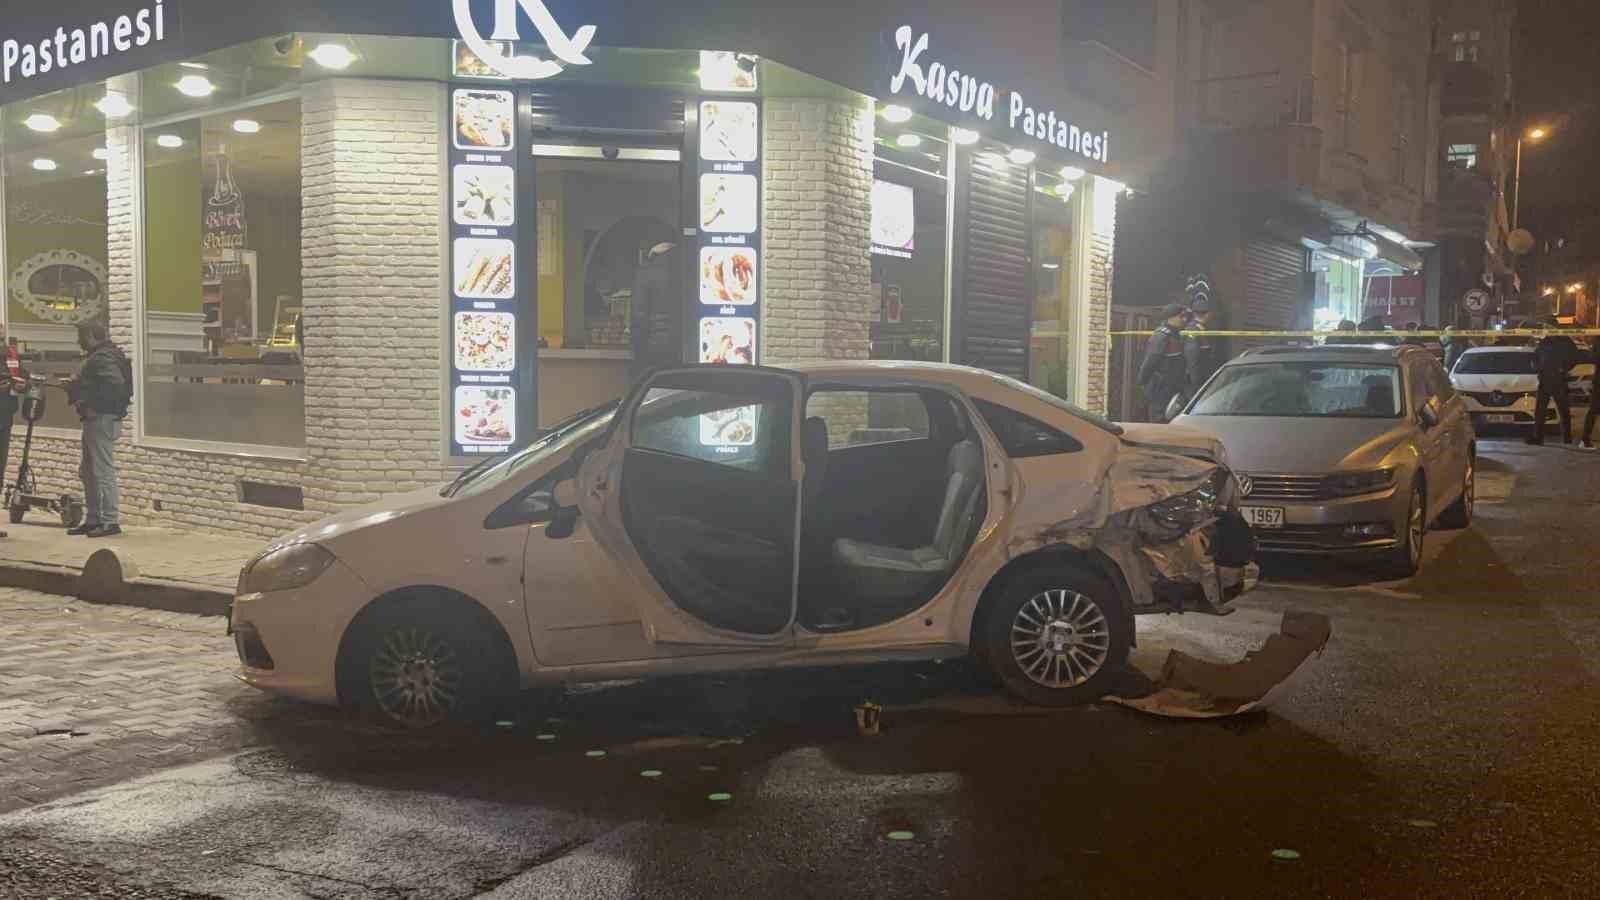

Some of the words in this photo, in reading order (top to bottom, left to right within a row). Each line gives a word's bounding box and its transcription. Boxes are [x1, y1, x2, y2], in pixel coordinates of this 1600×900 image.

[3, 0, 164, 83] Pastanesi
[890, 25, 994, 120] Kasva
[1009, 91, 1108, 163] Pastanesi
[1250, 509, 1281, 522] 1967
